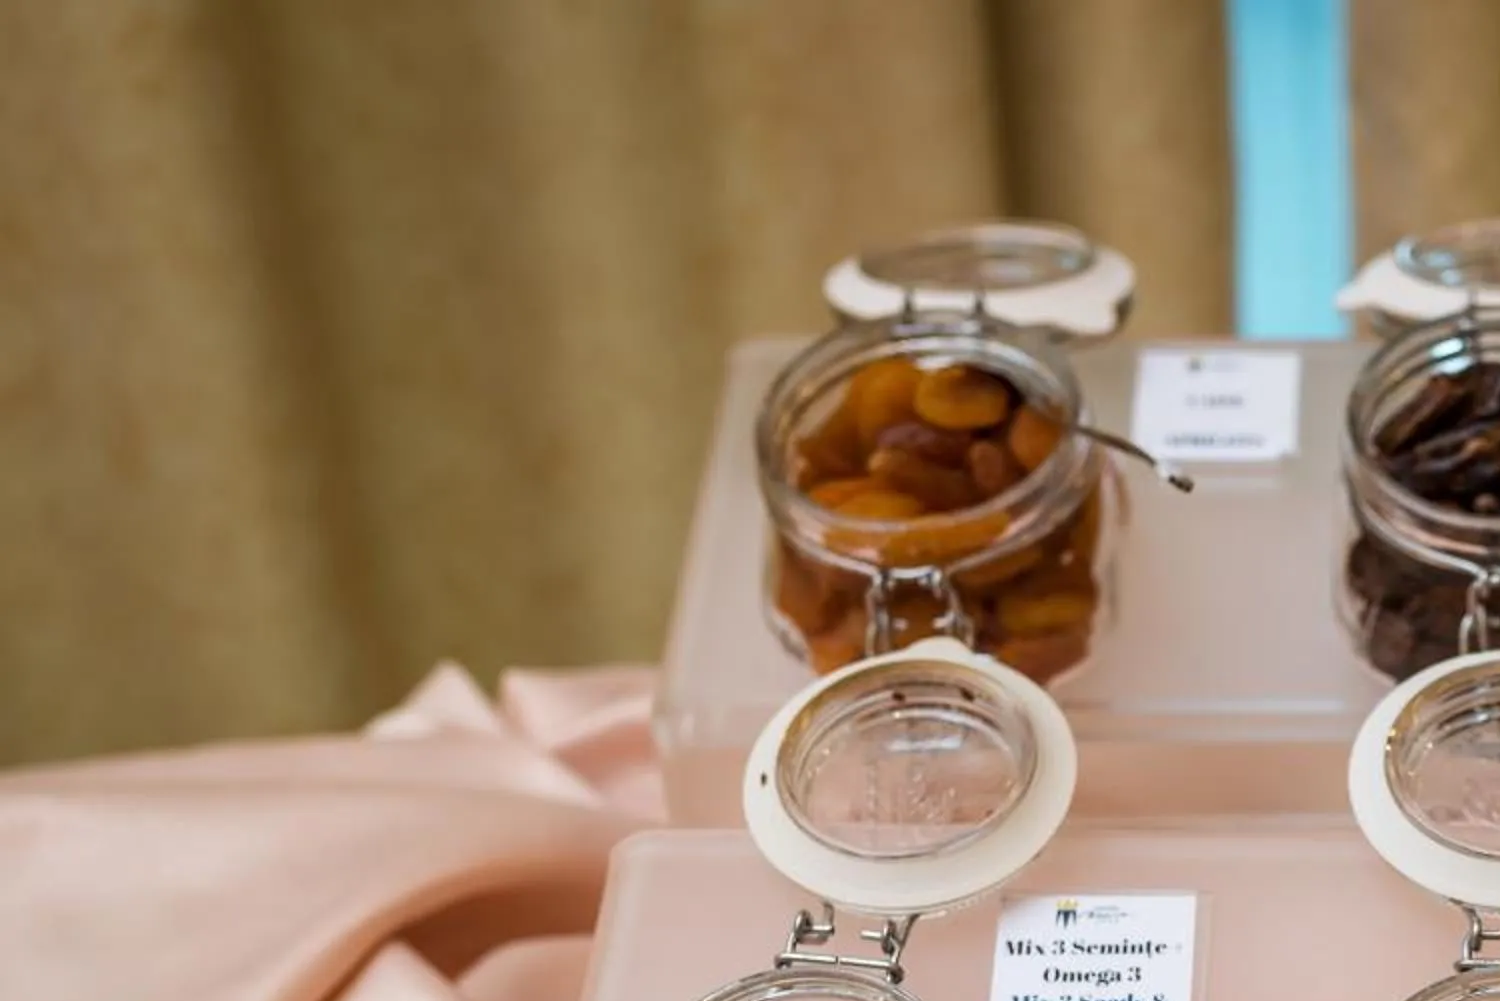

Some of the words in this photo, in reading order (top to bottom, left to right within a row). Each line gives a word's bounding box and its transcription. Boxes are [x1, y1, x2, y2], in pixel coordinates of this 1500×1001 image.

[1006, 939, 1045, 956] Mix
[1051, 941, 1066, 955] 3
[1042, 967, 1121, 986] Omega
[1127, 966, 1142, 982] 3
